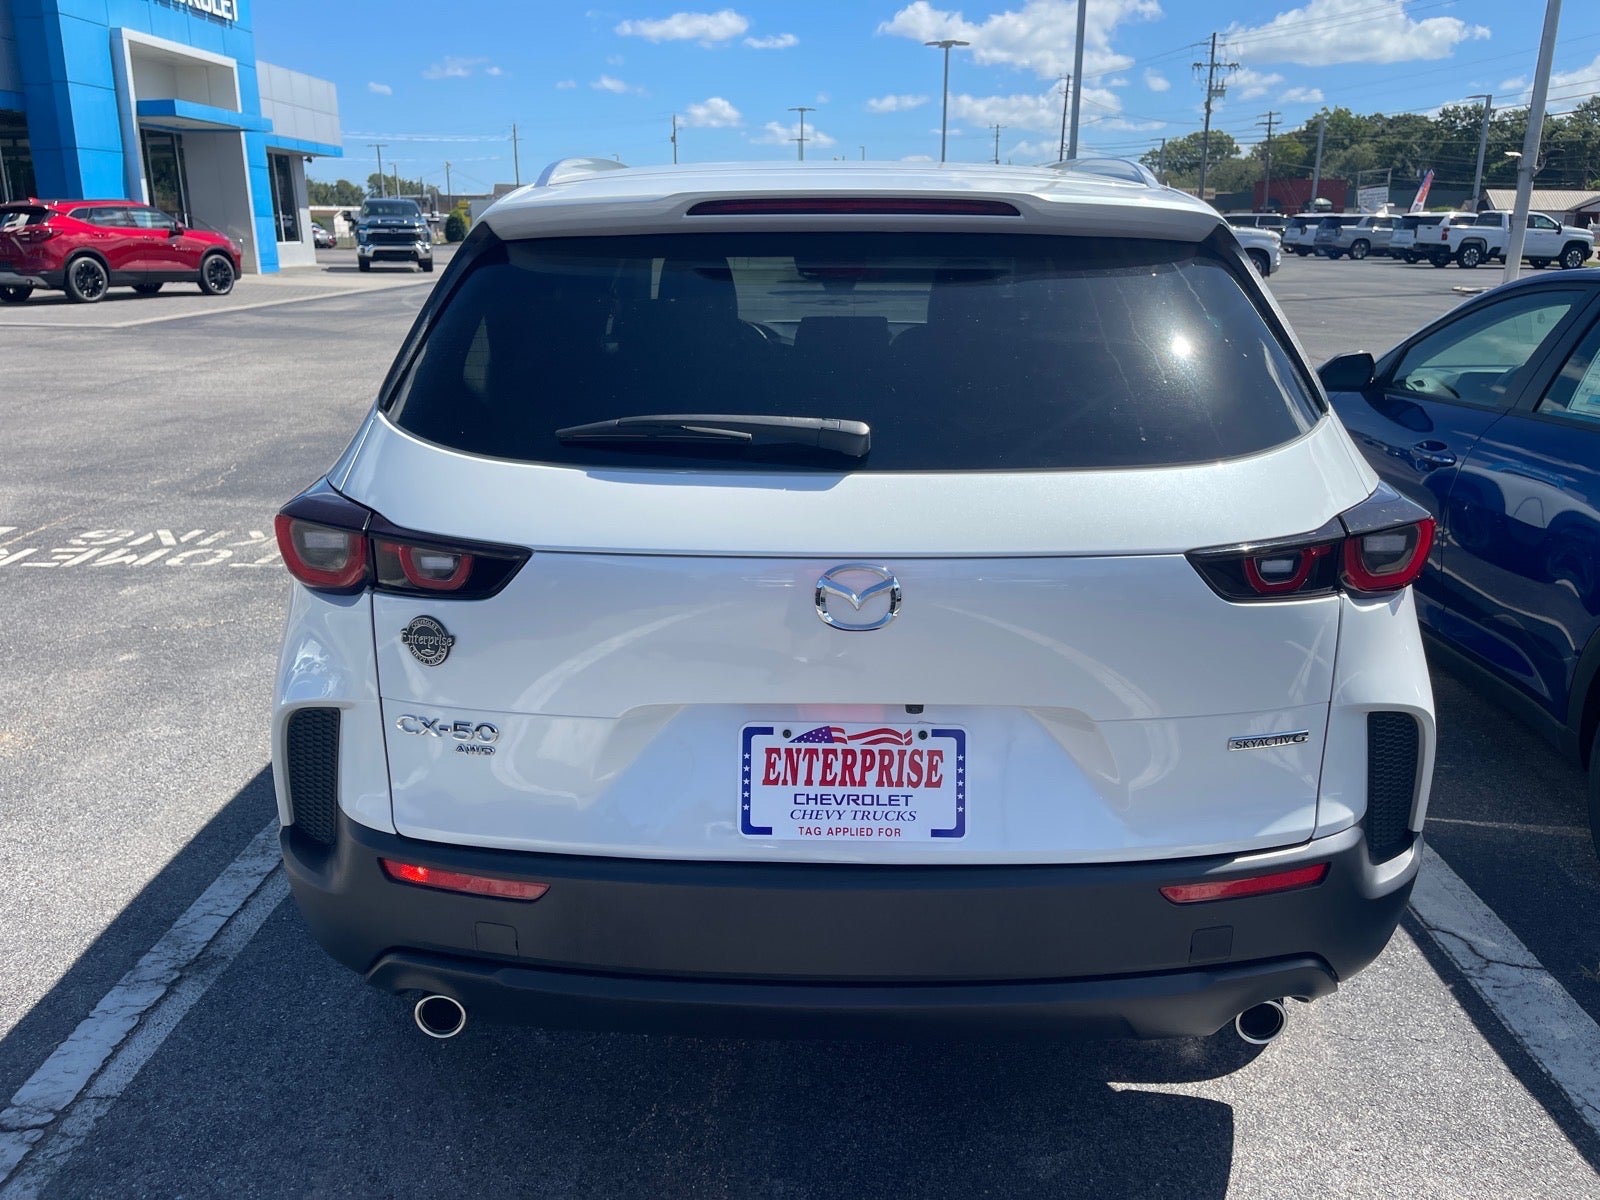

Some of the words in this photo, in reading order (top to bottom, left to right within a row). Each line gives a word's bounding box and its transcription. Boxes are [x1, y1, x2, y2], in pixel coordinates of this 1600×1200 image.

[400, 630, 453, 648] Enterprise
[396, 714, 499, 744] CX-50
[455, 743, 496, 756] AWD
[762, 747, 944, 789] ENTERPRISE
[793, 793, 913, 807] CHEVROLET
[790, 809, 846, 821] CHEVY
[850, 810, 917, 822] TRUCKS
[798, 826, 822, 836] TAG
[826, 827, 873, 837] APPLIED
[878, 827, 901, 837] FOR
